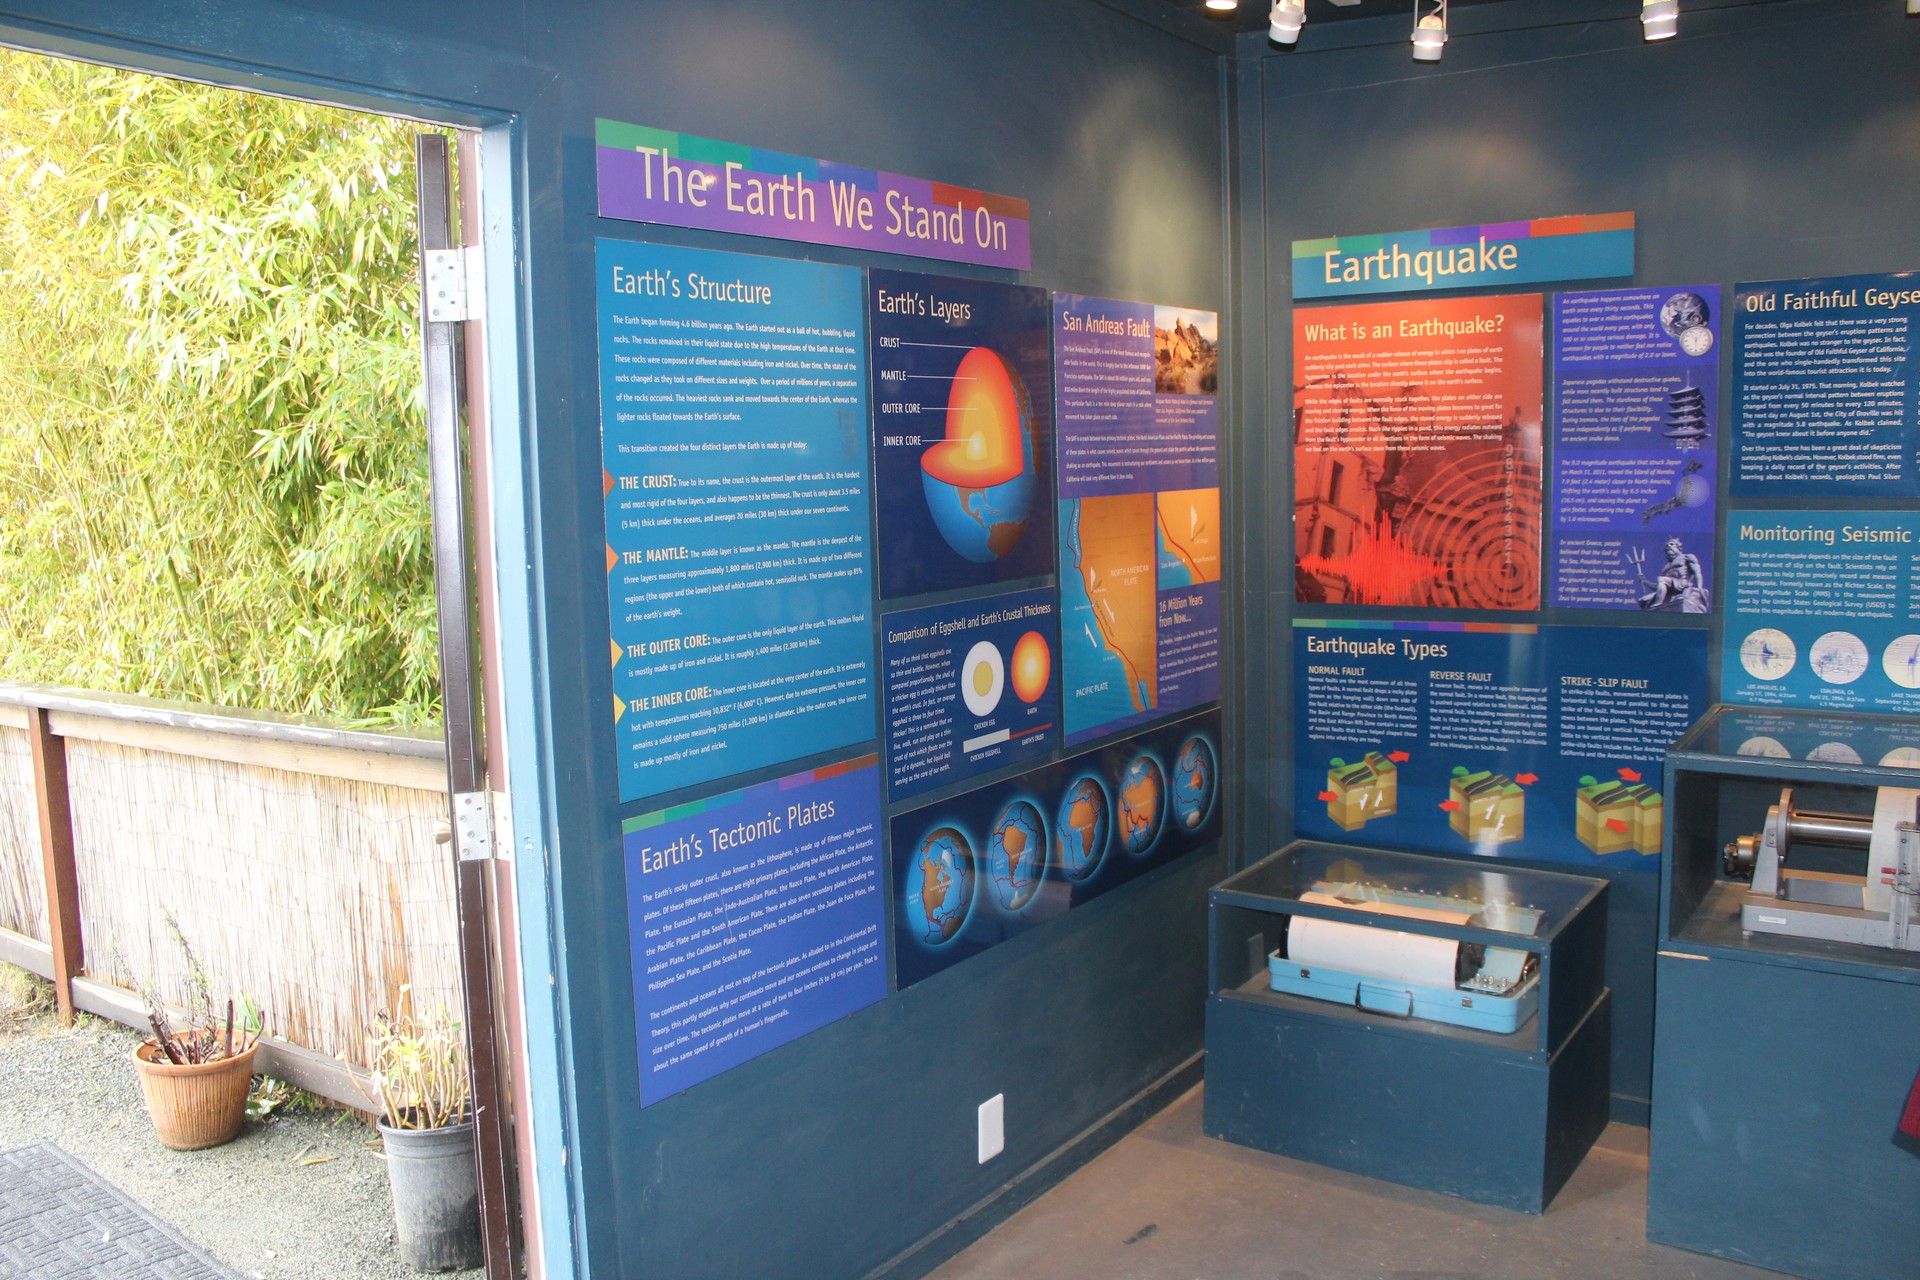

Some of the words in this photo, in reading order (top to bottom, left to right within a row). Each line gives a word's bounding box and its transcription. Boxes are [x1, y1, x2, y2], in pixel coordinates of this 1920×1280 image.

[636, 145, 707, 207] The
[725, 161, 815, 223] Earth
[829, 179, 873, 230] We
[885, 190, 964, 245] Stand
[974, 206, 1007, 251] On
[1324, 237, 1518, 285] Earthquake
[613, 265, 681, 298] Earth's
[688, 273, 772, 305] Structure
[878, 289, 925, 316] Earth's
[931, 295, 971, 323] Layers
[1746, 294, 1776, 313] Old
[1783, 289, 1858, 310] Faithful
[613, 315, 623, 323] The
[625, 315, 639, 324] Earth
[641, 318, 657, 327] began
[659, 318, 679, 328] forming
[691, 320, 707, 328] billion
[735, 322, 744, 330] The
[745, 323, 757, 331] Earth
[822, 328, 841, 337] bubbling,
[843, 329, 855, 338] liquid
[1063, 311, 1082, 331] San
[1086, 314, 1124, 336] Andreas
[1127, 318, 1151, 338] Fault
[1305, 324, 1347, 342] What
[1352, 322, 1366, 339] is
[1372, 325, 1392, 338] an
[1400, 315, 1504, 339] Earthquake?
[880, 337, 900, 348] CRUST
[881, 370, 906, 381] MANTLE
[882, 403, 903, 413] OUTER
[905, 403, 920, 413] CORE
[618, 444, 629, 452] This
[631, 444, 657, 452] transition
[702, 442, 721, 450] distinct
[722, 443, 736, 451] layers
[793, 441, 807, 449] today:
[883, 436, 903, 446] INNER
[906, 436, 921, 445] CORE
[620, 476, 639, 490] THE
[642, 475, 677, 488] CRUST:
[1740, 525, 1835, 545] Monitoring
[1842, 526, 1912, 543] Seismic
[623, 551, 642, 564] THE
[646, 547, 688, 562] MANTLE:
[1125, 577, 1138, 585] PLATE
[1159, 601, 1166, 612] 16
[1168, 597, 1187, 611] Million
[1188, 595, 1203, 606] Years
[888, 625, 928, 643] Comparison
[930, 623, 937, 635] of
[939, 618, 965, 635] Eggshell
[967, 616, 979, 627] and
[981, 612, 1001, 625] Earth's
[1002, 609, 1022, 621] Crustal
[1025, 604, 1051, 616] Thickness
[1159, 616, 1172, 628] from
[627, 645, 646, 658] THE
[649, 640, 681, 655] OUTER
[684, 634, 711, 649] CORE:
[1308, 636, 1396, 658] Earthquake
[1402, 639, 1448, 660] Types
[1308, 666, 1340, 675] NORMAL
[1342, 667, 1365, 676] FAULT
[1430, 671, 1465, 680] REVERSE
[1467, 672, 1492, 682] FAULT
[1076, 684, 1094, 697] PACIFIC
[1095, 682, 1108, 692] PLATE
[1621, 679, 1649, 689] FAULT
[630, 699, 649, 713] THE
[652, 693, 682, 709] INNER
[685, 686, 712, 703] CORE:
[1027, 707, 1037, 715] EARTH
[642, 836, 703, 874] Earth's
[709, 812, 782, 852] Tectonic
[787, 800, 835, 830] Plates
[643, 893, 652, 902] The
[654, 886, 672, 899] Earth's
[674, 883, 688, 894] rocky
[689, 878, 703, 887] outer
[705, 872, 719, 883] crust,
[721, 868, 731, 877] also
[733, 864, 748, 873] known
[757, 857, 765, 866] the
[767, 848, 793, 863] lithosphere,
[801, 842, 812, 851] made
[827, 832, 841, 843] fifteen
[843, 829, 854, 839] major
[856, 823, 873, 833] tectonic
[654, 1060, 668, 1072] about
[669, 1055, 678, 1065] the
[680, 1050, 692, 1061] same
[694, 1042, 708, 1055] speed
[716, 1032, 732, 1046] growth
[744, 1019, 763, 1032] human's
[764, 1008, 789, 1024] fingernails.
